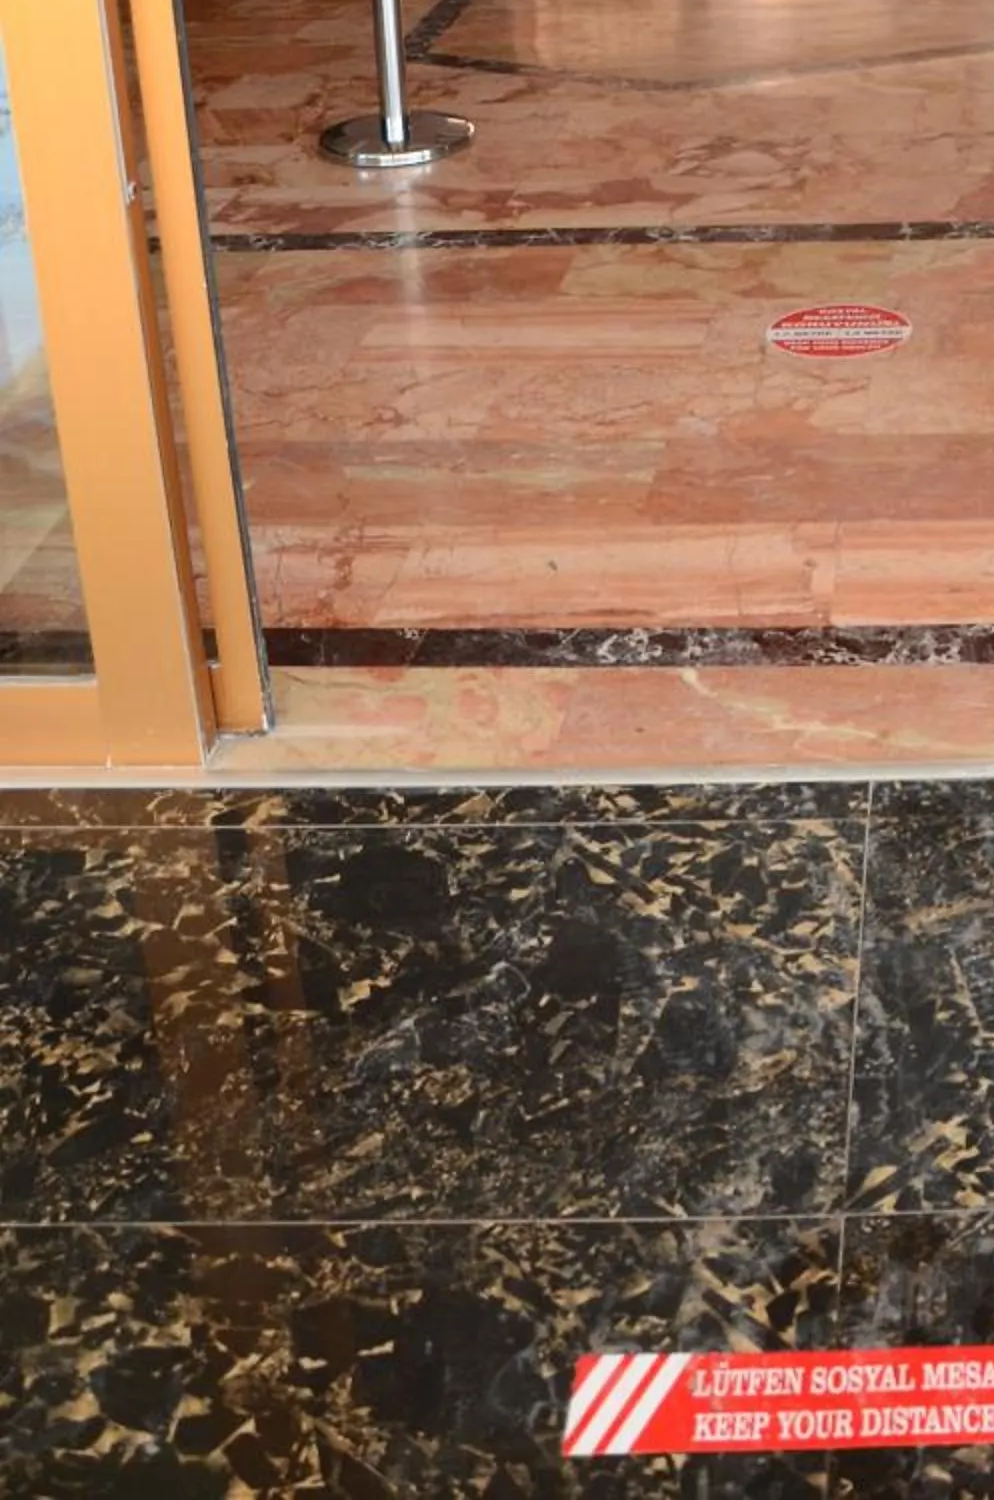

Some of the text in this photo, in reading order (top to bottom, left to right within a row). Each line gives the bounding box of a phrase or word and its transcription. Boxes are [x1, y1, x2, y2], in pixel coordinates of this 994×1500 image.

[693, 1362, 803, 1396] LÜTFEN
[810, 1364, 916, 1393] SOSYAL
[692, 1412, 769, 1442] KEEP
[776, 1409, 855, 1440] YOUR
